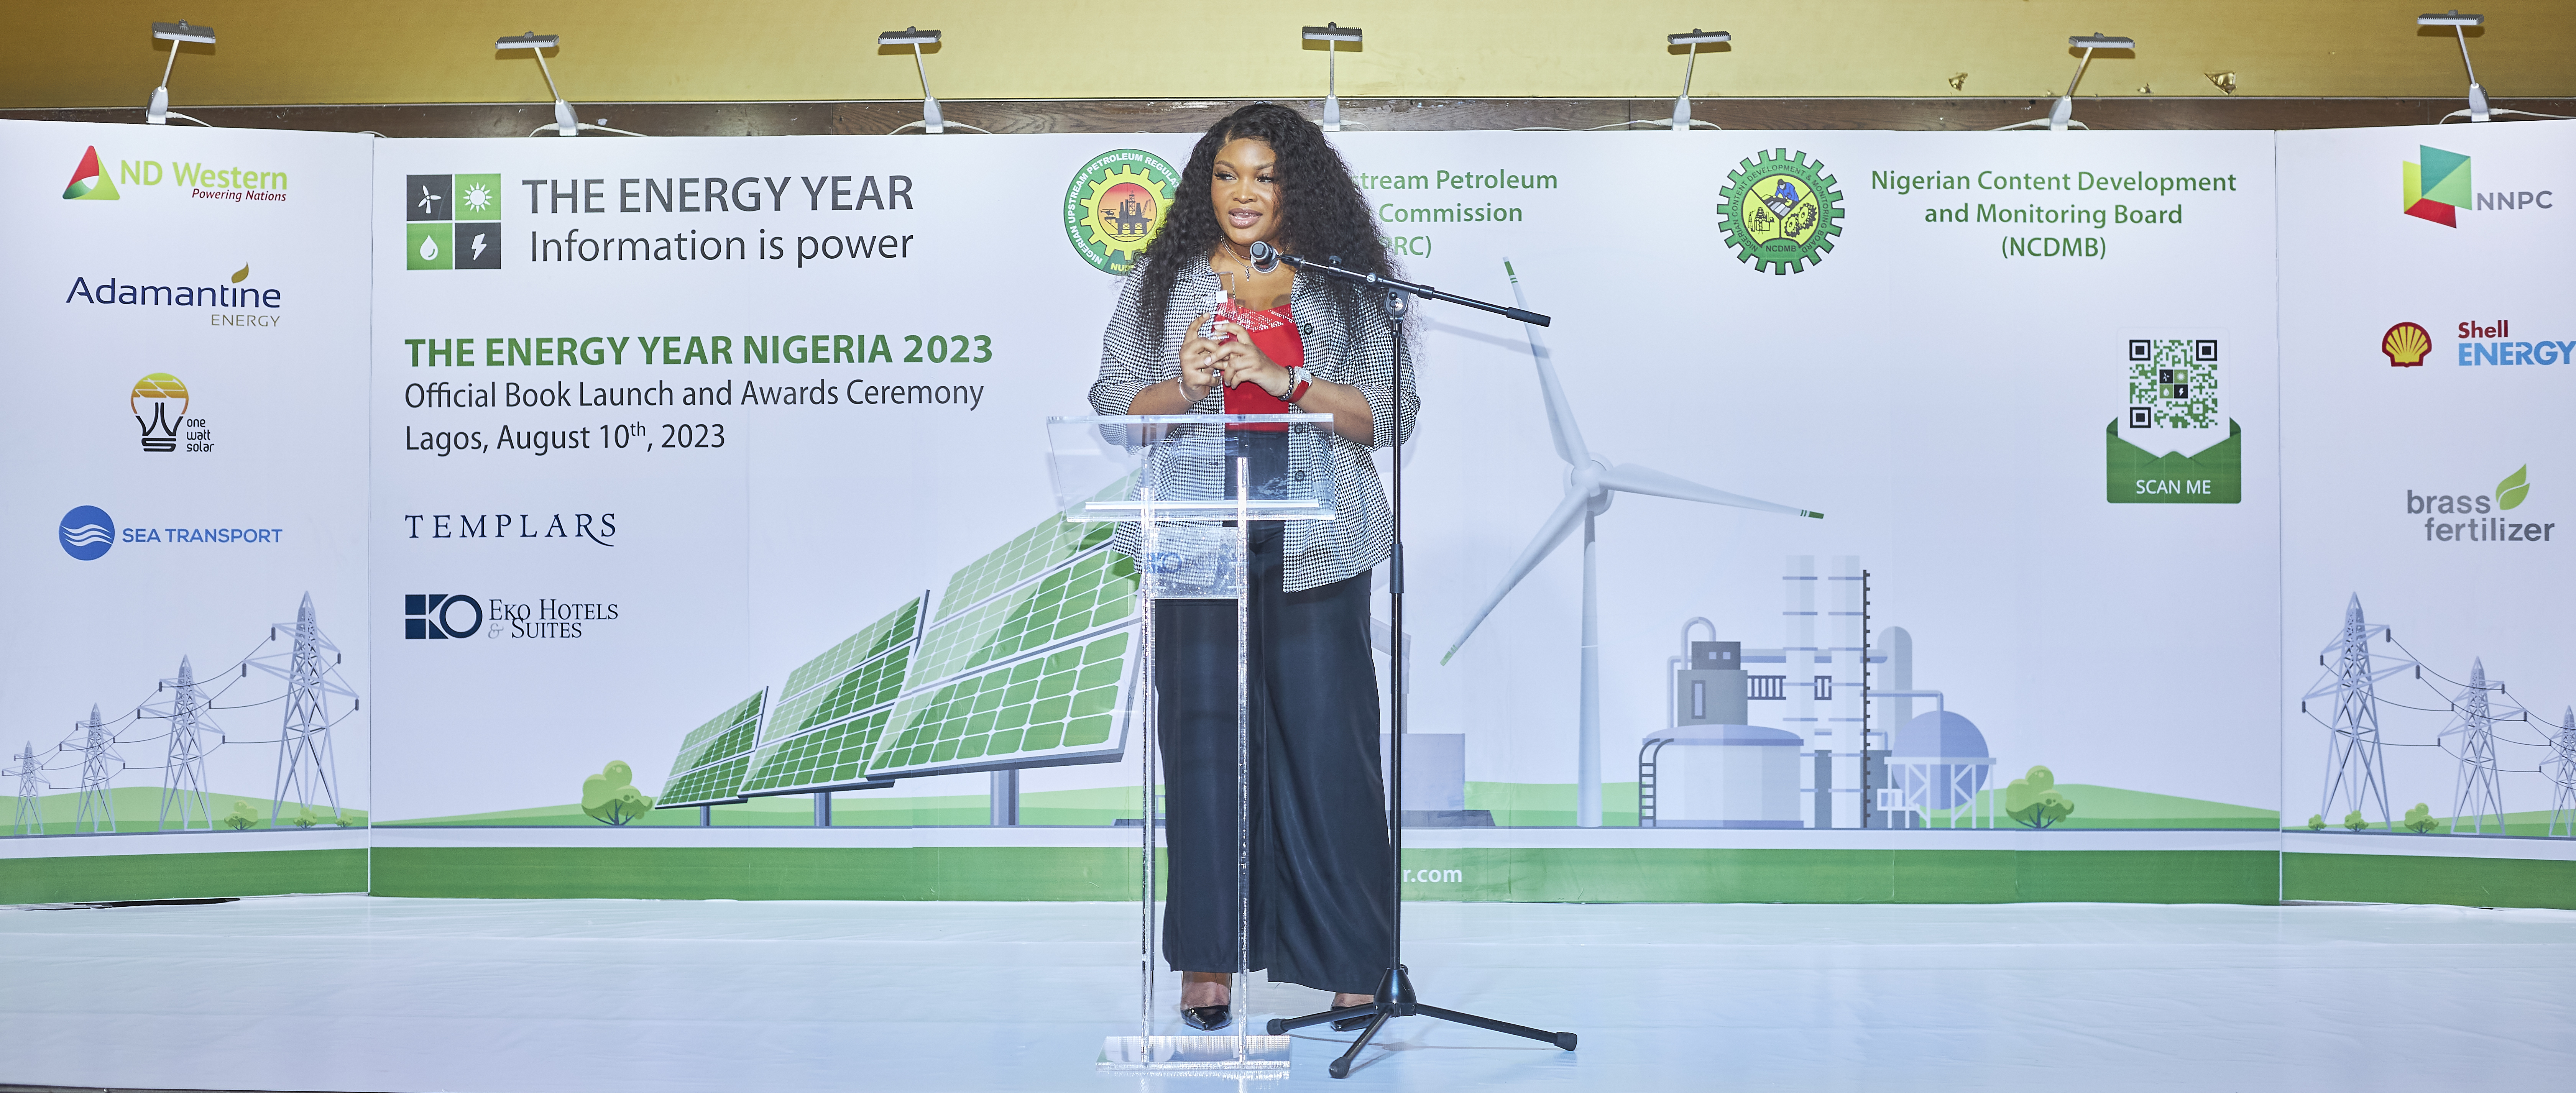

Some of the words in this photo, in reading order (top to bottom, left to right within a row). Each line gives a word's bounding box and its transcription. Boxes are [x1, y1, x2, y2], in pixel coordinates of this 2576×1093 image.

[121, 160, 163, 185] ND
[172, 162, 287, 190] Western
[1086, 153, 1143, 174] PETROLEUM
[1145, 156, 1180, 188] REGULAT
[1747, 164, 1806, 182] DEVELOPMENT
[1437, 169, 1557, 189] Petroleum
[1872, 170, 1970, 195] Nigerian
[1978, 171, 2070, 190] Content
[2079, 171, 2236, 196] Development
[192, 188, 242, 202] Powering
[245, 190, 286, 201] Nations
[522, 179, 605, 213] THE
[620, 177, 791, 212] ENERGY
[801, 175, 913, 210] YEAR
[1068, 172, 1088, 223] UPSTREAM
[1732, 181, 1748, 217] CONTENT
[1812, 180, 1829, 229] MONITORING
[2477, 190, 2553, 210] NNPC
[1379, 202, 1522, 222] Commission
[1925, 203, 1968, 223] and
[1977, 204, 2106, 229] Monitoring
[2115, 204, 2182, 224] Board
[1070, 225, 1102, 264] NIGERIAN
[1733, 219, 1758, 252] NIGERIAN
[1802, 230, 1824, 253] BOARD
[2002, 236, 2106, 259] (NCDMB)
[531, 229, 745, 262] Information
[760, 229, 784, 259] is
[798, 235, 914, 268] power
[66, 277, 281, 308] Adamantine
[212, 314, 280, 327] ENERGY
[2458, 320, 2508, 339] Shell
[404, 338, 474, 367] THE
[486, 337, 630, 366] ENERGY
[637, 336, 733, 364] YEAR
[744, 335, 893, 364] NIGERIA
[904, 335, 992, 363] 2023
[2459, 341, 2576, 366] ENERGY
[405, 382, 495, 408] Official
[506, 381, 571, 407] Book
[580, 380, 673, 406] Launch
[683, 379, 731, 405] and
[741, 379, 838, 405] Awards
[847, 379, 984, 411] Ceremony
[187, 418, 205, 427] one
[187, 430, 210, 440] watt
[187, 441, 214, 452] solar
[406, 426, 488, 457] Lagos,
[497, 425, 590, 456] August
[662, 424, 724, 448] 2023
[2136, 479, 2180, 494] SCAN
[2187, 480, 2211, 494] ME
[2407, 490, 2490, 514] brass
[122, 528, 161, 543] SEA
[165, 528, 283, 543] TRANSPORT
[405, 514, 615, 547] TEMPLARS
[2425, 517, 2555, 542] fertilizer
[488, 624, 503, 639] &
[1403, 869, 1462, 883] r.com
